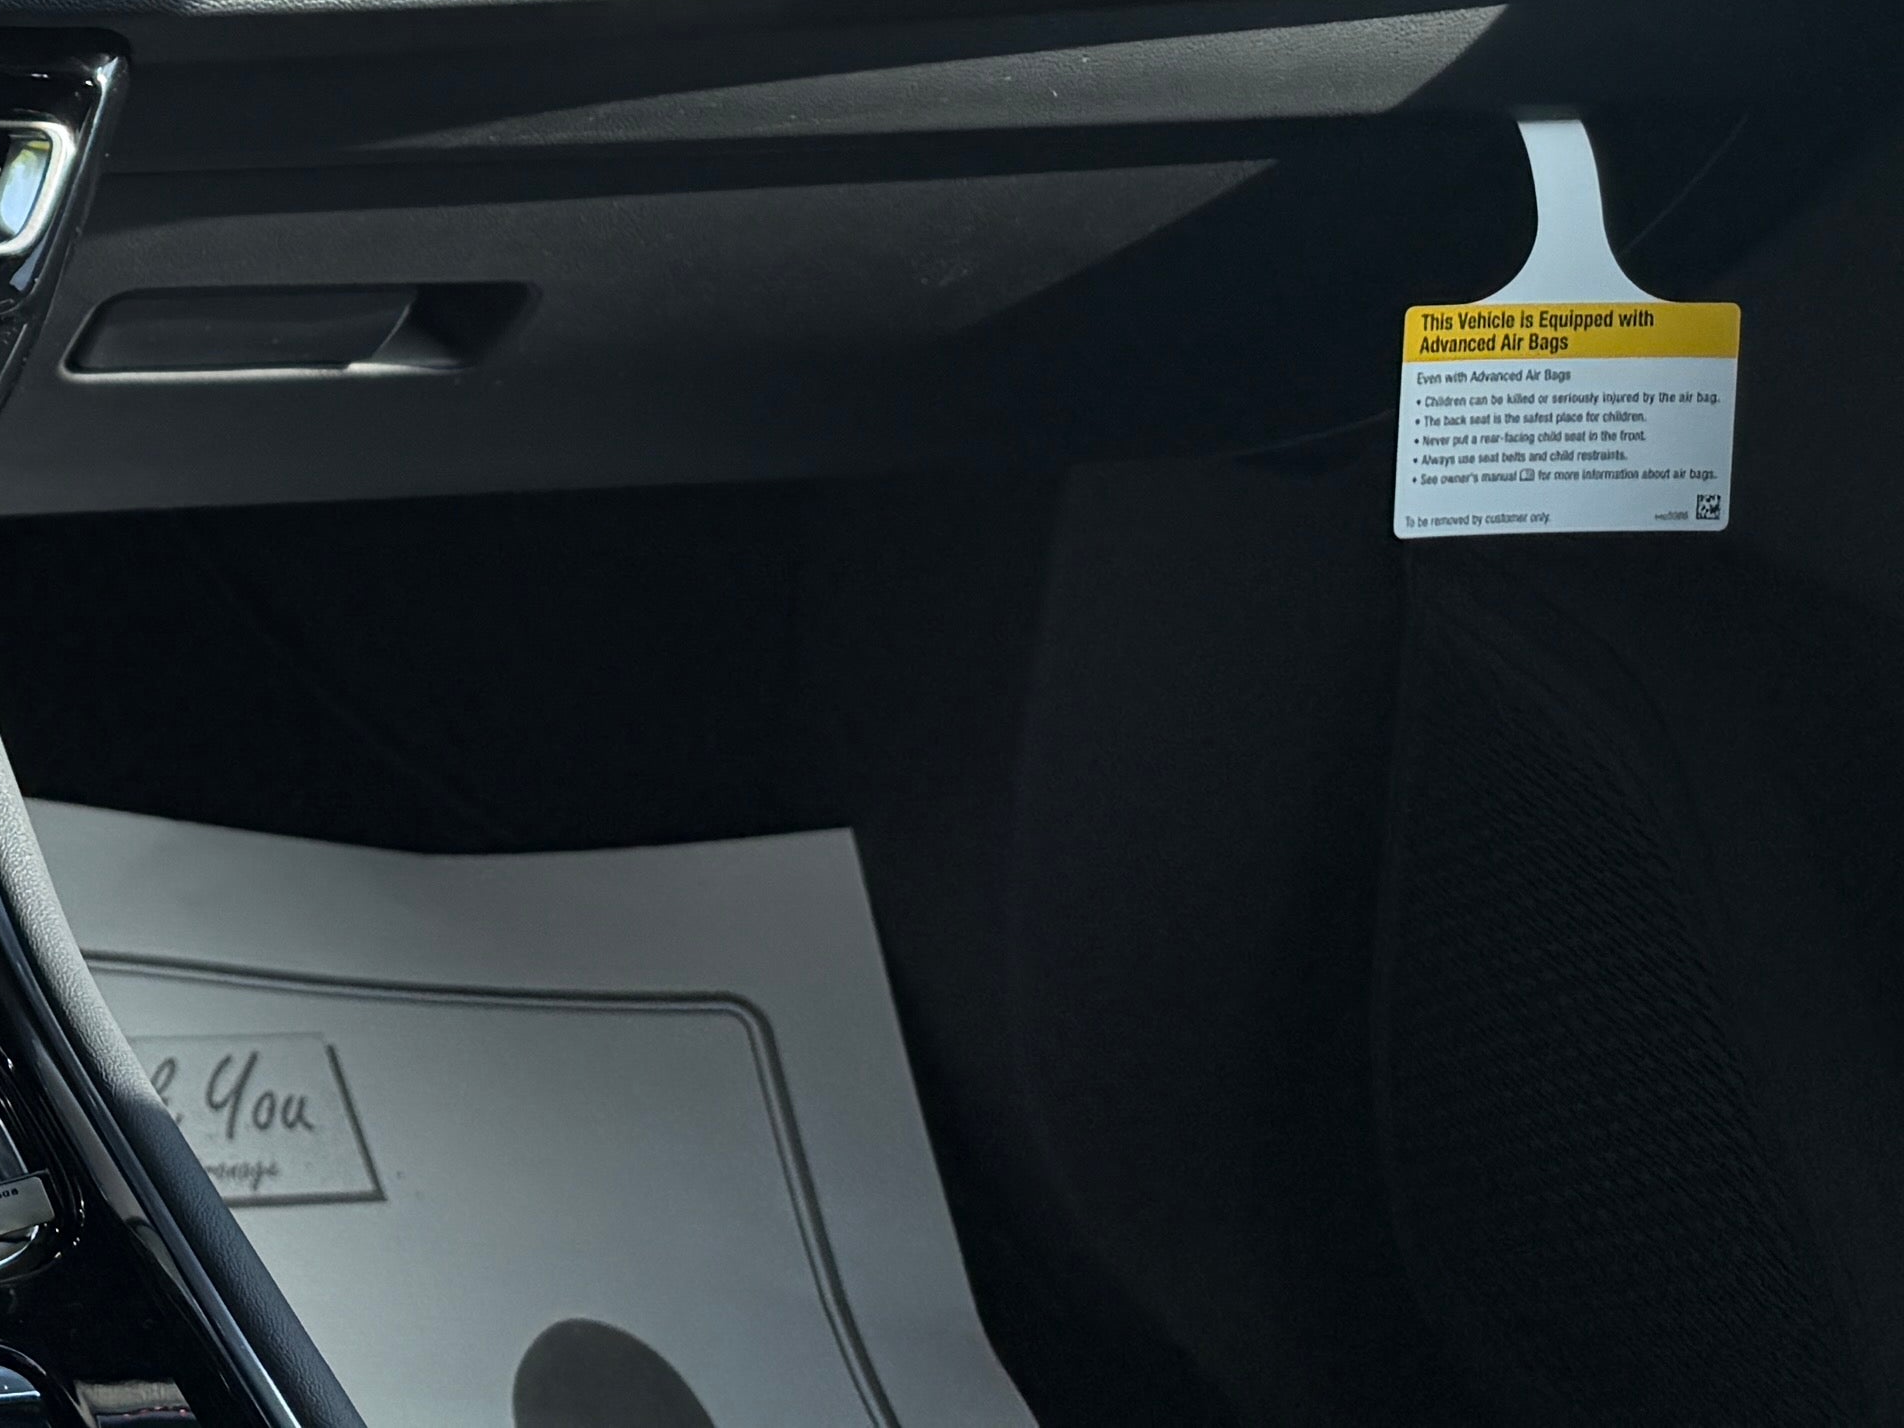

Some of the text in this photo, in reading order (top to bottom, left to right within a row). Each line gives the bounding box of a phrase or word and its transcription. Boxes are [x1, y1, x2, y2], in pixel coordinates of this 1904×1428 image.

[1421, 309, 1654, 331] This Vehicle is Equipped with
[1419, 333, 1568, 354] Advanced Air Bags
[1417, 369, 1571, 385] Even with Advanced Air Bags
[1425, 392, 1720, 407] Children can be killed or seriously injured by the air bag.
[1424, 411, 1646, 427] The back seat is the safest place for children.
[1422, 436, 1450, 446] Never
[1453, 435, 1469, 447] put
[1480, 432, 1535, 445] rear-facing
[1538, 432, 1561, 442] child
[1564, 433, 1585, 442] seat
[1589, 431, 1597, 441] in
[1601, 431, 1617, 441] the
[1620, 430, 1646, 441] front.
[1421, 450, 1628, 467] Always use seat belts and child restraints.
[1420, 469, 1717, 485] See owner's manual for more information about air bags.
[1406, 516, 1415, 528] To
[1418, 516, 1427, 527] be
[1431, 515, 1469, 526] removed
[1472, 515, 1482, 526] by
[1485, 513, 1527, 524] customer
[205, 1051, 315, 1140] You
